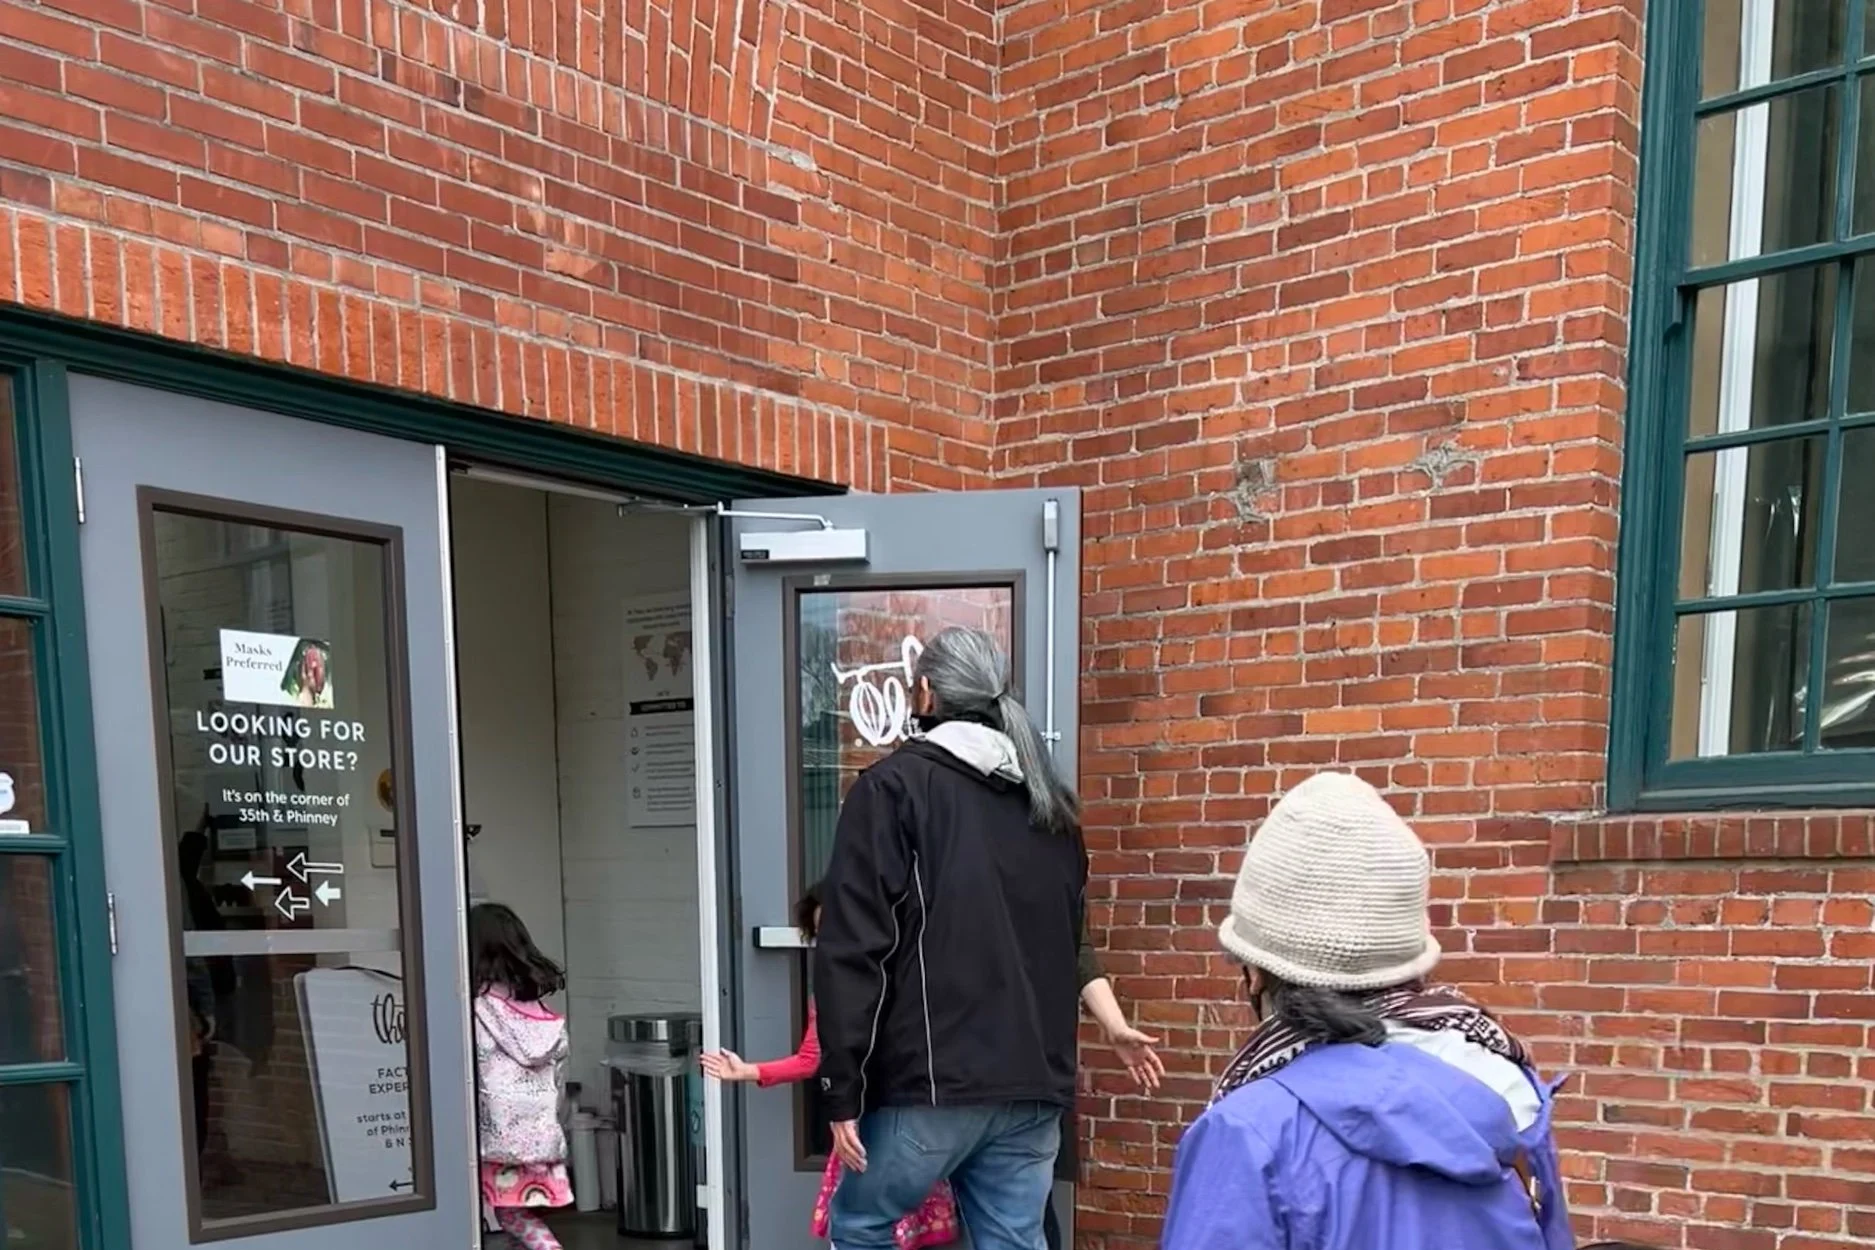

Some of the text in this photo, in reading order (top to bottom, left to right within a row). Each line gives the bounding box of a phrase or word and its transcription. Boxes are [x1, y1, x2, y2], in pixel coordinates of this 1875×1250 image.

[234, 642, 272, 656] Masks
[226, 656, 283, 672] Preferred
[196, 710, 366, 742] LOOKING FOR
[209, 742, 359, 771] OUR STORE?
[222, 788, 350, 807] It's on the corner of
[239, 808, 338, 827] 35th & Phinney
[356, 1111, 391, 1123] starts
[366, 1126, 378, 1137] of
